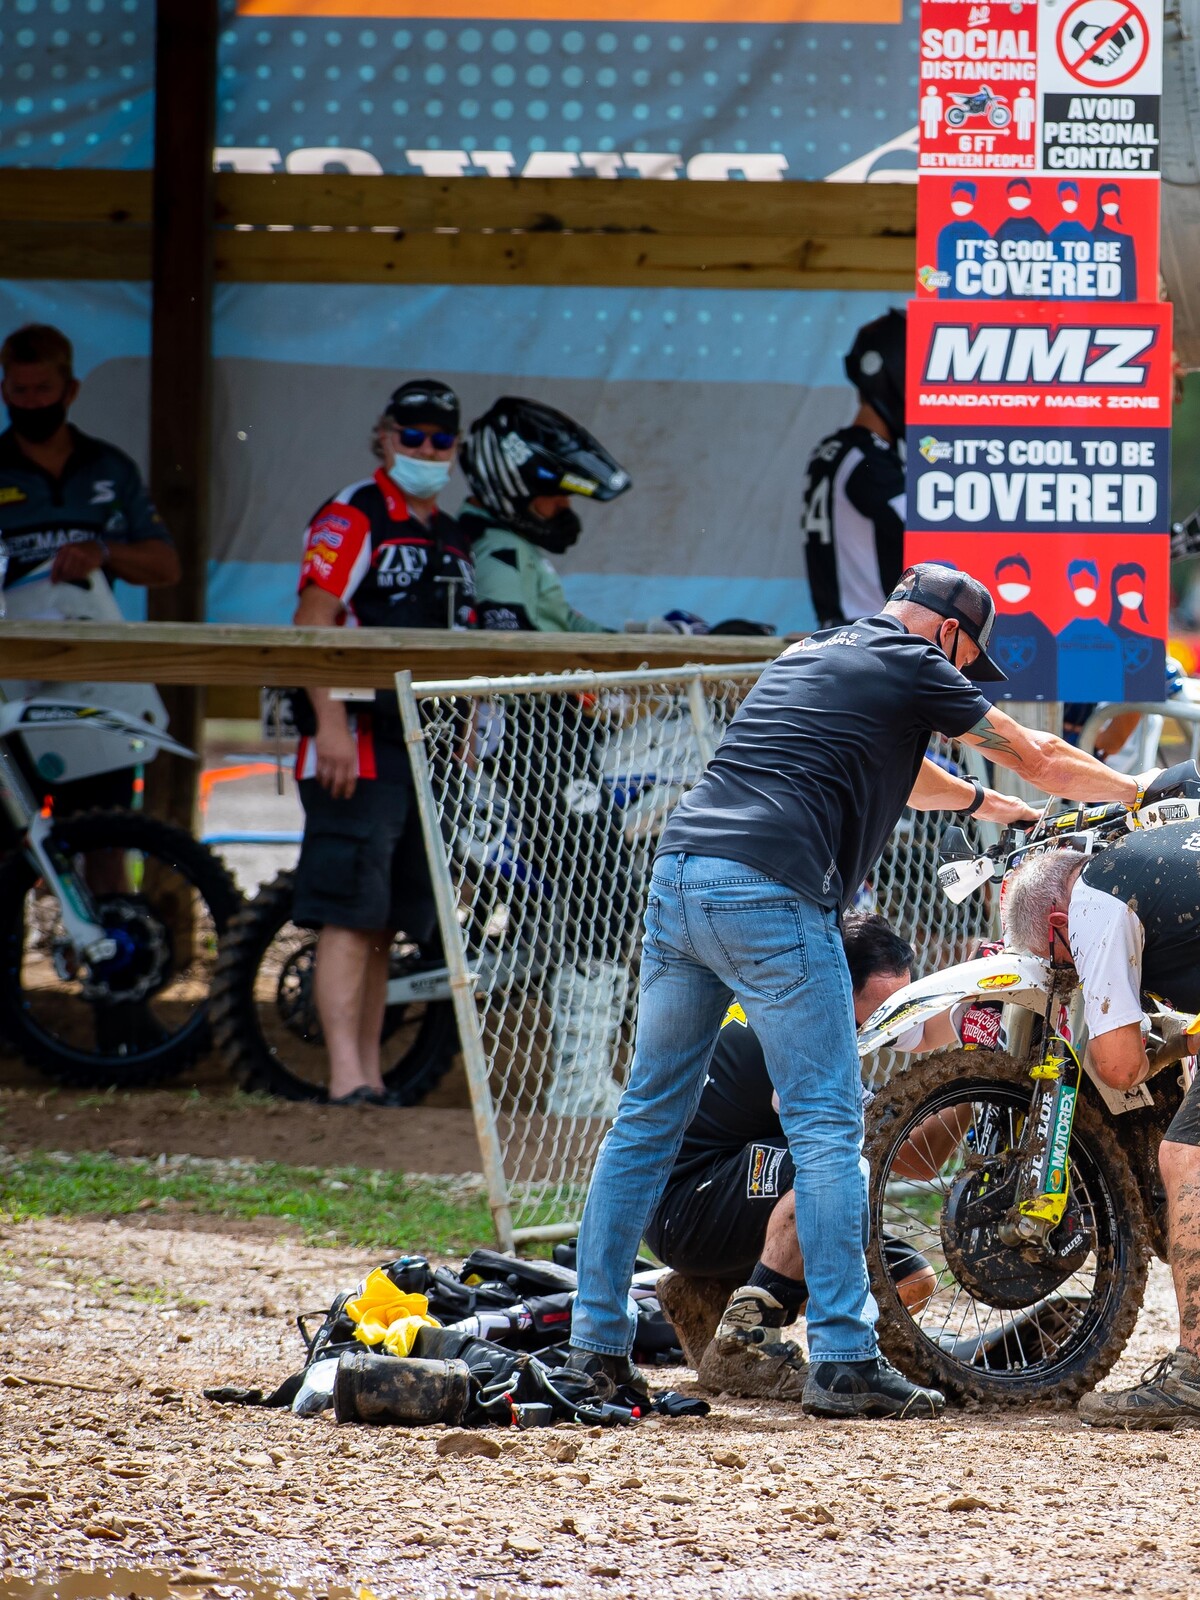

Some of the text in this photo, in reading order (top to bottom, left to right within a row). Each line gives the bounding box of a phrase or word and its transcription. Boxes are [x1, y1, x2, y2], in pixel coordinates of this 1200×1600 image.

[921, 28, 1036, 59] SOCIAL
[921, 61, 1036, 81] DISTANCING
[1067, 98, 1135, 120] AVOID
[958, 135, 997, 153] 6 FT
[1044, 122, 1159, 145] PERSONAL
[920, 152, 1035, 168] BETWEEN PEOPLE
[1047, 148, 1155, 170] CONTACT
[956, 239, 1122, 262] IT'S COOL TO BE
[955, 259, 1122, 297] COVERED
[923, 325, 1157, 385] MMZ
[919, 393, 1160, 409] MANDATORY MASK ZONE
[953, 439, 1156, 467] IT'S COOL TO BE
[916, 470, 1159, 524] COVERED
[1051, 1091, 1075, 1169] MOTOREX
[1060, 1233, 1084, 1257] GALFER
